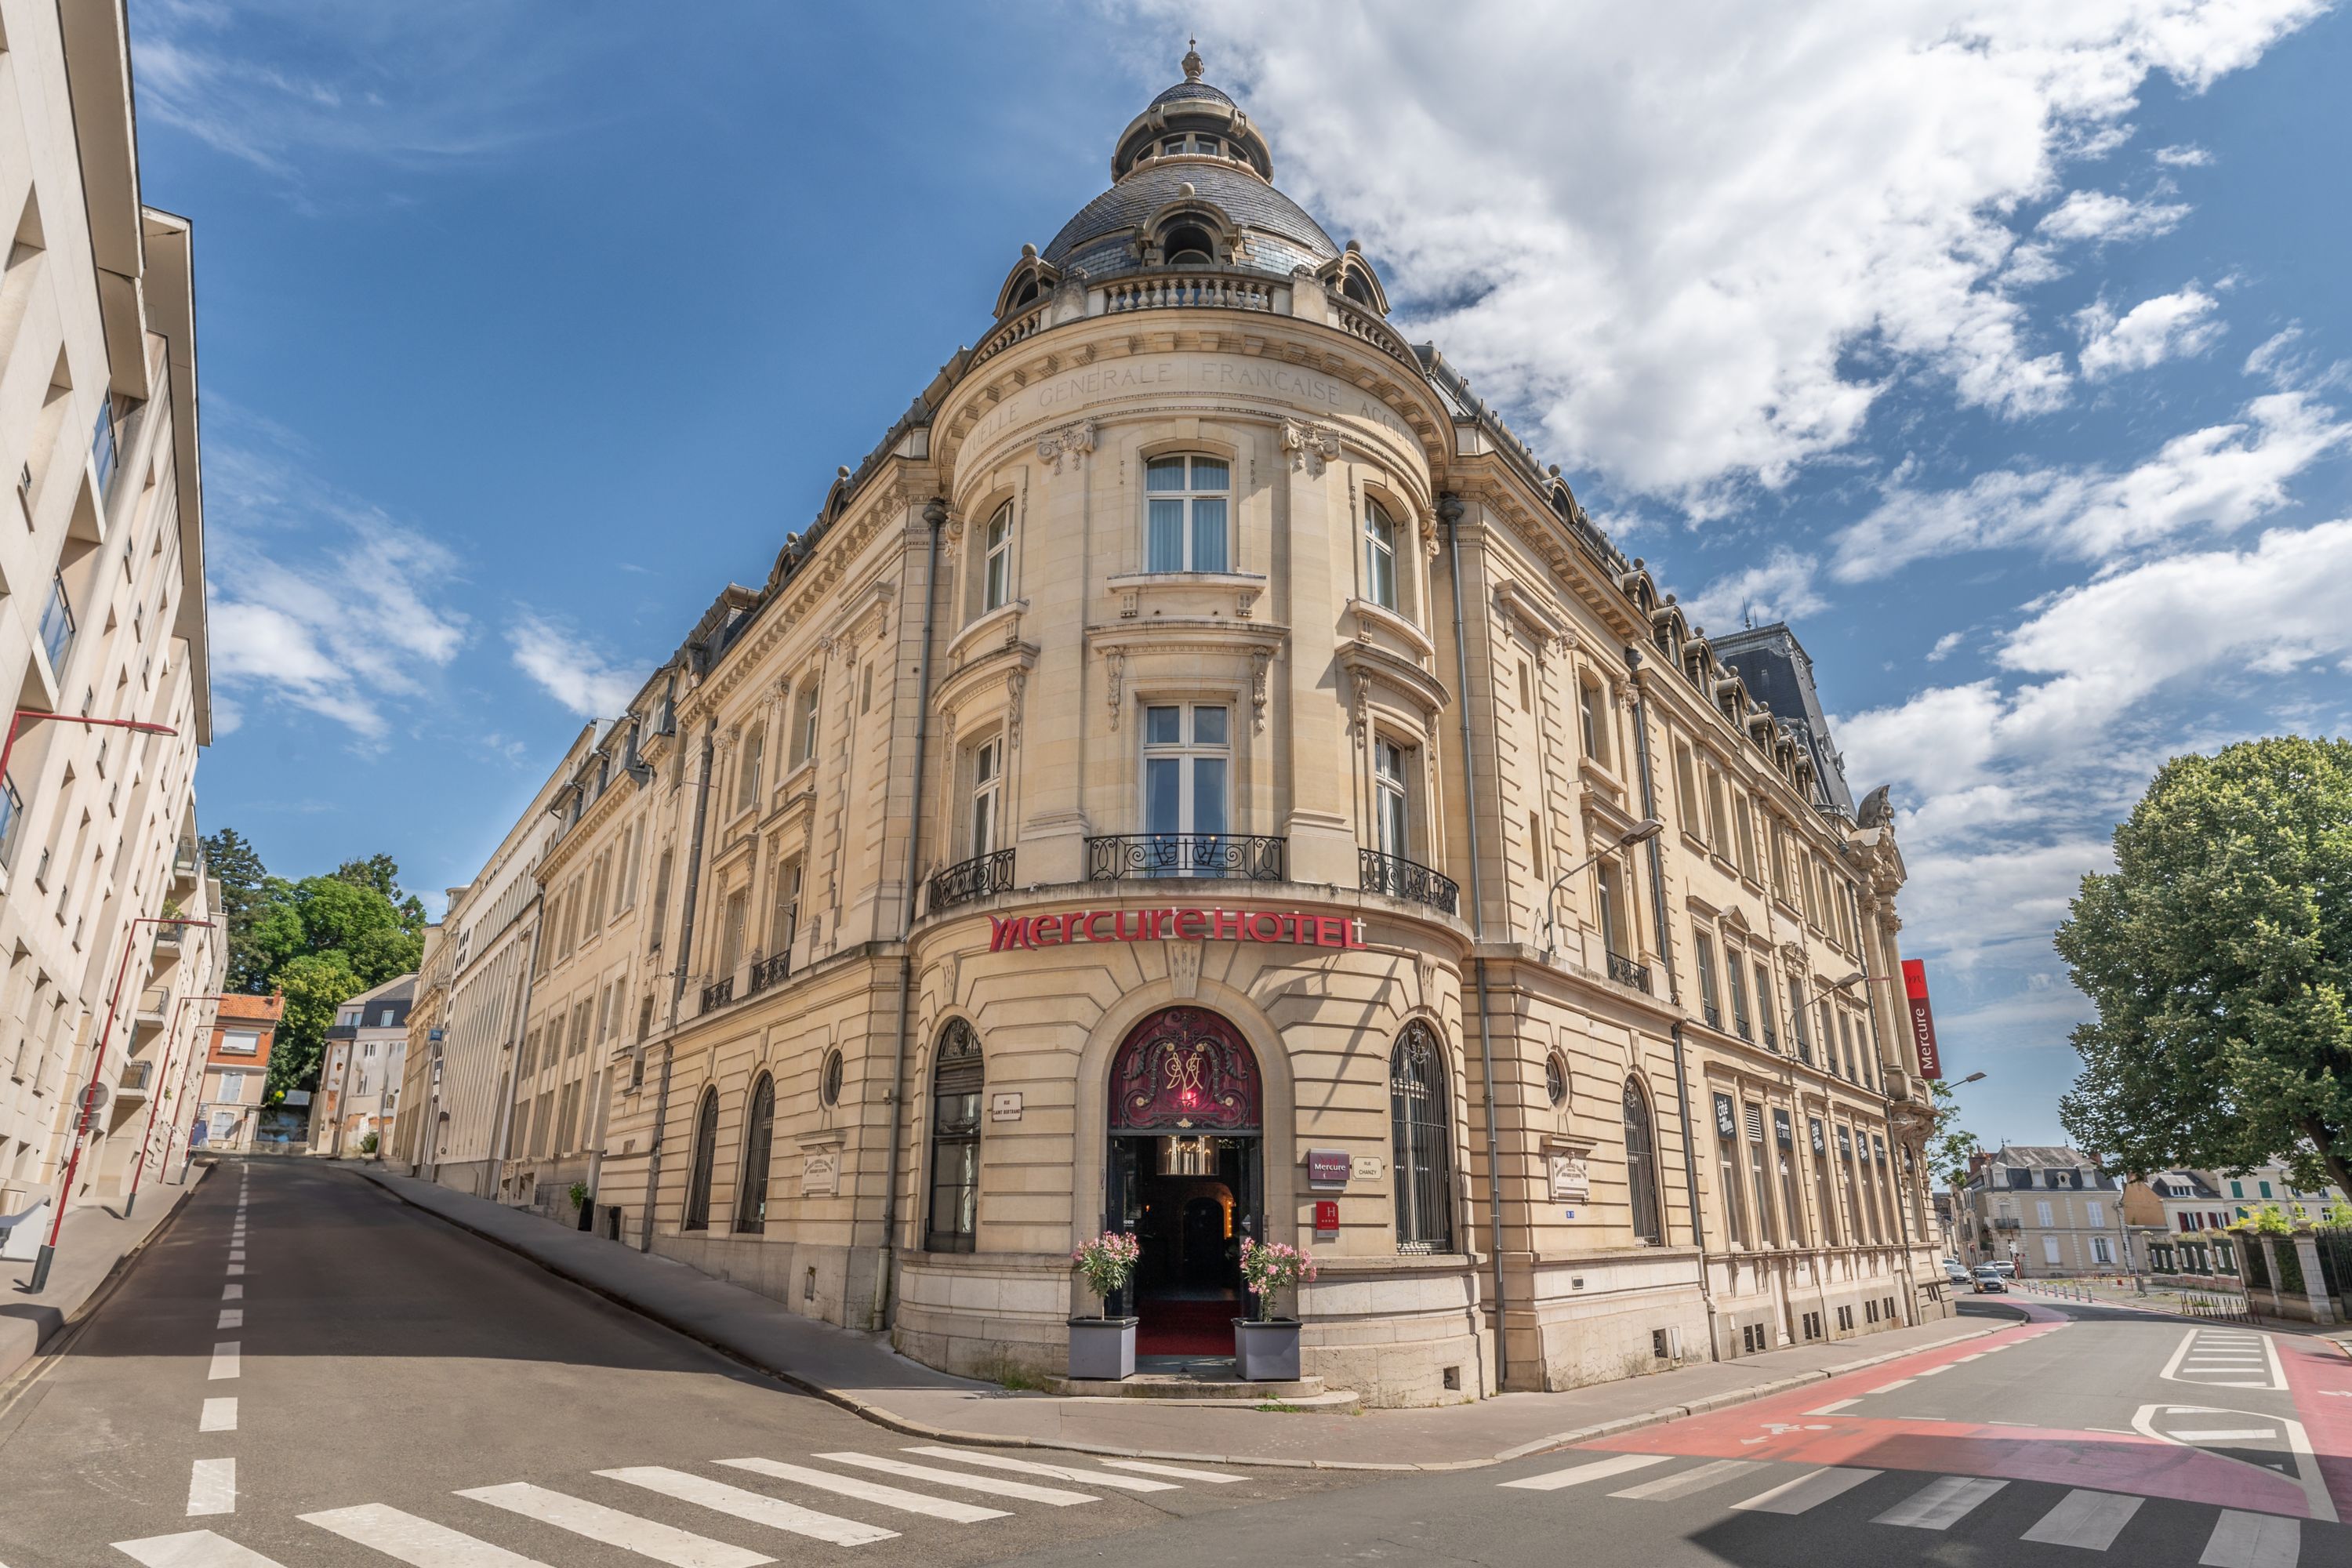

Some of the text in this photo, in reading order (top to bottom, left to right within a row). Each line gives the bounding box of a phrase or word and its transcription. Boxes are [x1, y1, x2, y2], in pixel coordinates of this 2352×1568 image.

[1040, 363, 1172, 407] GENERALE
[1360, 401, 1427, 472] ACCIDEN
[1213, 909, 1367, 950] HOTEL
[1915, 1008, 1933, 1069] Mercure
[1327, 1207, 1335, 1217] H
